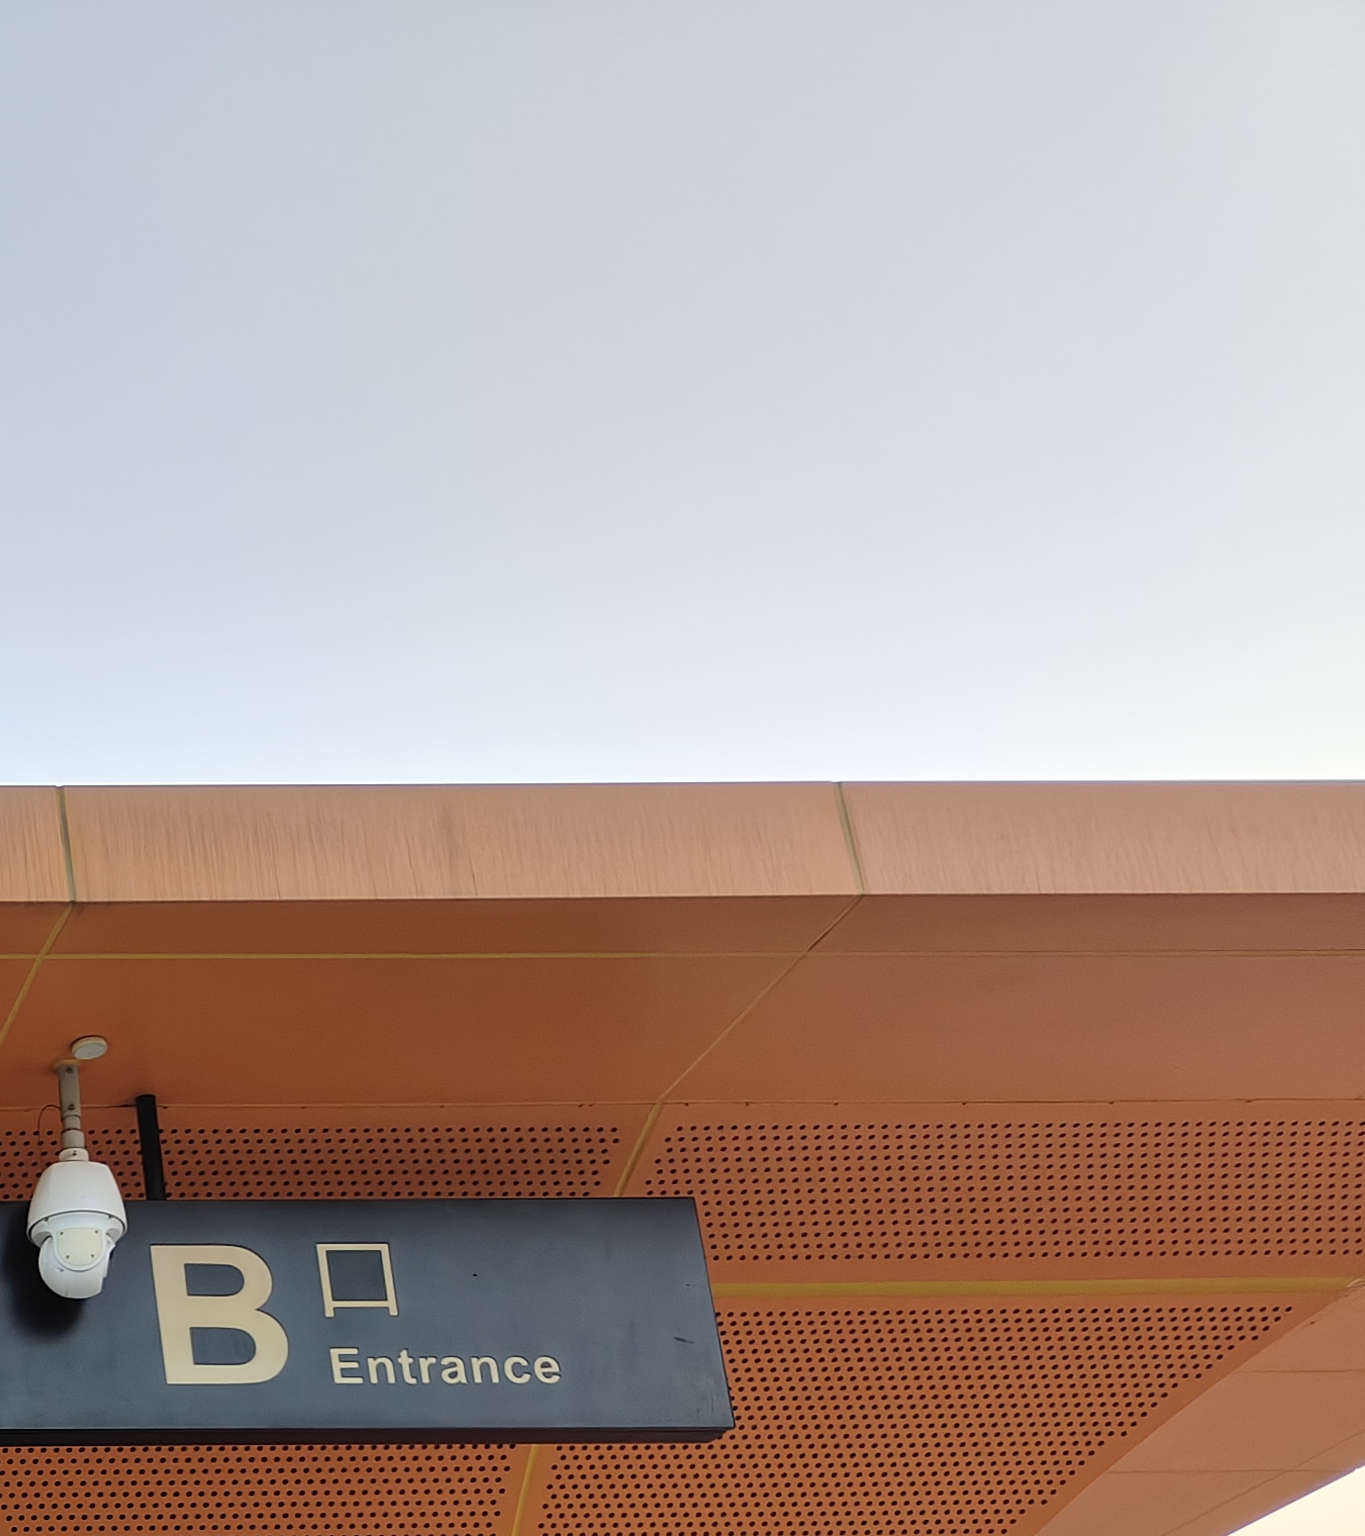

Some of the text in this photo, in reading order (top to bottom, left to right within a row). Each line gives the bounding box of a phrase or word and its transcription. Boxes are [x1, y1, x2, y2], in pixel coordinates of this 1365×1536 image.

[150, 1245, 289, 1385] B
[315, 1243, 399, 1317] 口
[329, 1348, 561, 1385] Entrance
